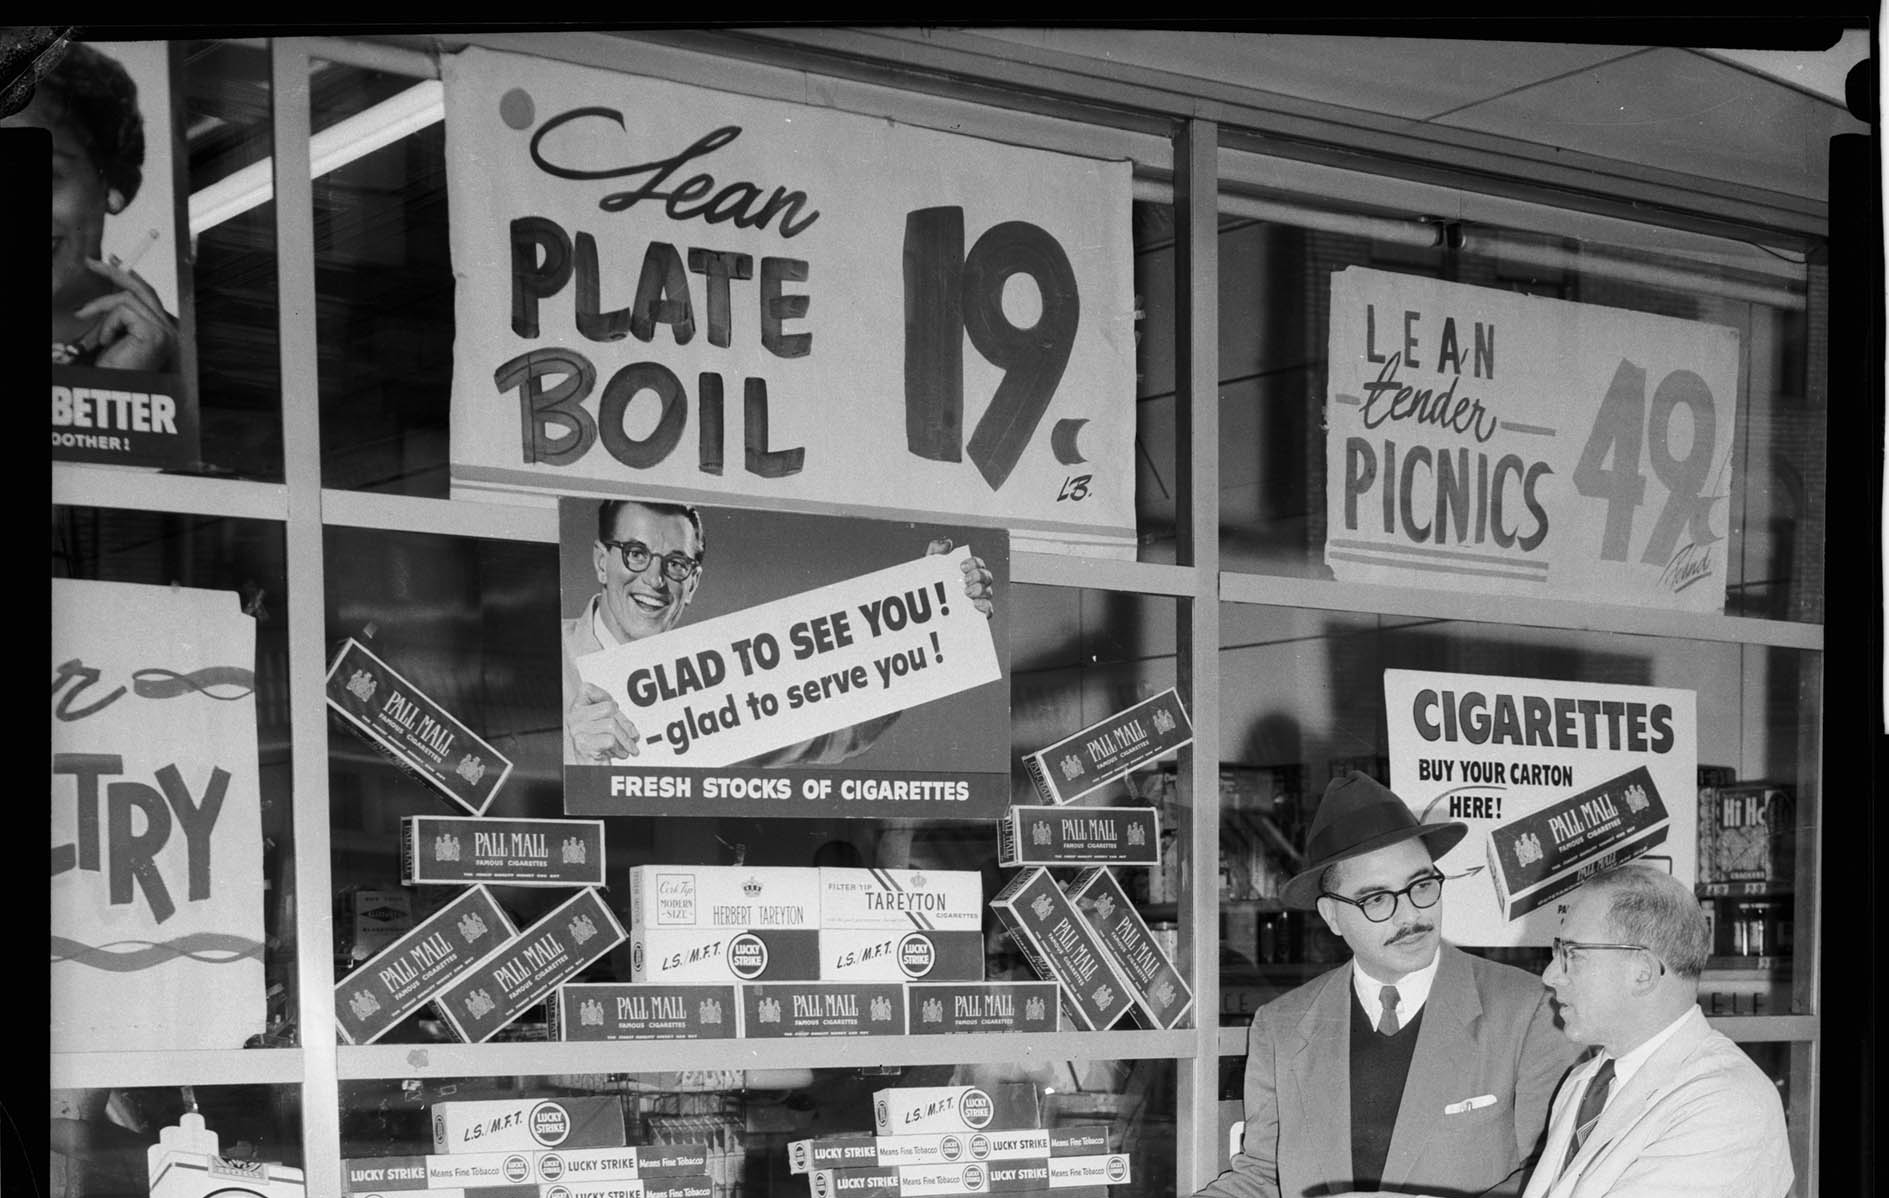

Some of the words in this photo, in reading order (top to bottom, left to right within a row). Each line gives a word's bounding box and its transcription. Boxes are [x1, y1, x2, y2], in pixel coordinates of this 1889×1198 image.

[529, 106, 819, 238] Lean
[510, 216, 812, 359] PLATE
[1366, 304, 1495, 380] LEAN
[52, 385, 178, 435] BETTER
[1361, 351, 1497, 443] tender
[493, 347, 805, 478] BOIL
[1344, 436, 1555, 552] PICNICS
[626, 648, 726, 708] GLAD
[731, 632, 781, 676] TO
[789, 610, 854, 661] SEE
[747, 689, 780, 722] to
[788, 659, 868, 709] serve
[382, 690, 417, 734] PALL
[415, 715, 455, 756] MALL
[1413, 688, 1676, 755] CIGARETTES
[378, 712, 404, 735] FAMOUS
[406, 734, 443, 765] CIGARETTES
[1087, 737, 1118, 763] PALL
[1113, 718, 1148, 748] MALL
[1418, 758, 1454, 783] BUY
[1459, 760, 1506, 785] YOUR
[1510, 763, 1573, 788] CARTON
[611, 775, 692, 798] FRESH
[703, 777, 791, 800] STOCKS
[802, 779, 831, 800] OF
[840, 780, 969, 801] CIGARETTES
[1449, 795, 1502, 820] HERE!
[1548, 808, 1586, 845] PALL
[1580, 793, 1619, 830] MALL
[1061, 818, 1087, 841] PALL
[1089, 818, 1117, 842] MALL
[474, 832, 507, 858] PALL
[511, 833, 548, 858] MALL
[475, 859, 504, 867] FAMOUS
[507, 859, 548, 868] CIGARETTES
[828, 883, 856, 892] FILTER
[859, 884, 873, 892] TIP
[865, 891, 946, 912] TAREYTON
[713, 905, 751, 926] HERBERT
[759, 905, 804, 926] TAREYTON
[935, 911, 979, 920] CIGARETTES
[734, 944, 761, 954] LUCKY
[1115, 914, 1141, 948] PALL
[1133, 941, 1161, 980] MALL
[378, 959, 414, 994] PALL
[410, 932, 454, 970] MALL
[492, 959, 528, 994] PALL
[523, 932, 565, 970] MALL
[733, 955, 763, 967] STRIKE
[793, 995, 823, 1018] PALL
[824, 994, 859, 1018] MALL
[964, 1098, 987, 1109] LUCKY
[964, 1107, 990, 1118] STRIKE
[536, 1121, 566, 1134] STRIKE
[537, 1111, 562, 1123] LUCKY
[568, 1159, 597, 1172] LUCKY
[600, 1157, 635, 1170] STRIKE
[814, 1148, 843, 1160] LUCKY
[844, 1146, 876, 1158] STRIKE
[880, 1147, 899, 1156] Means
[900, 1145, 912, 1156] Fine
[912, 1145, 938, 1155] Tobacco
[351, 1167, 385, 1182] LUCKY
[387, 1166, 425, 1181] STRIKE
[430, 1168, 453, 1178] Means
[454, 1167, 470, 1177] Fine
[471, 1166, 500, 1177] Tobacco
[990, 1169, 1017, 1181] LUCKY
[1018, 1167, 1048, 1180] STRIKE
